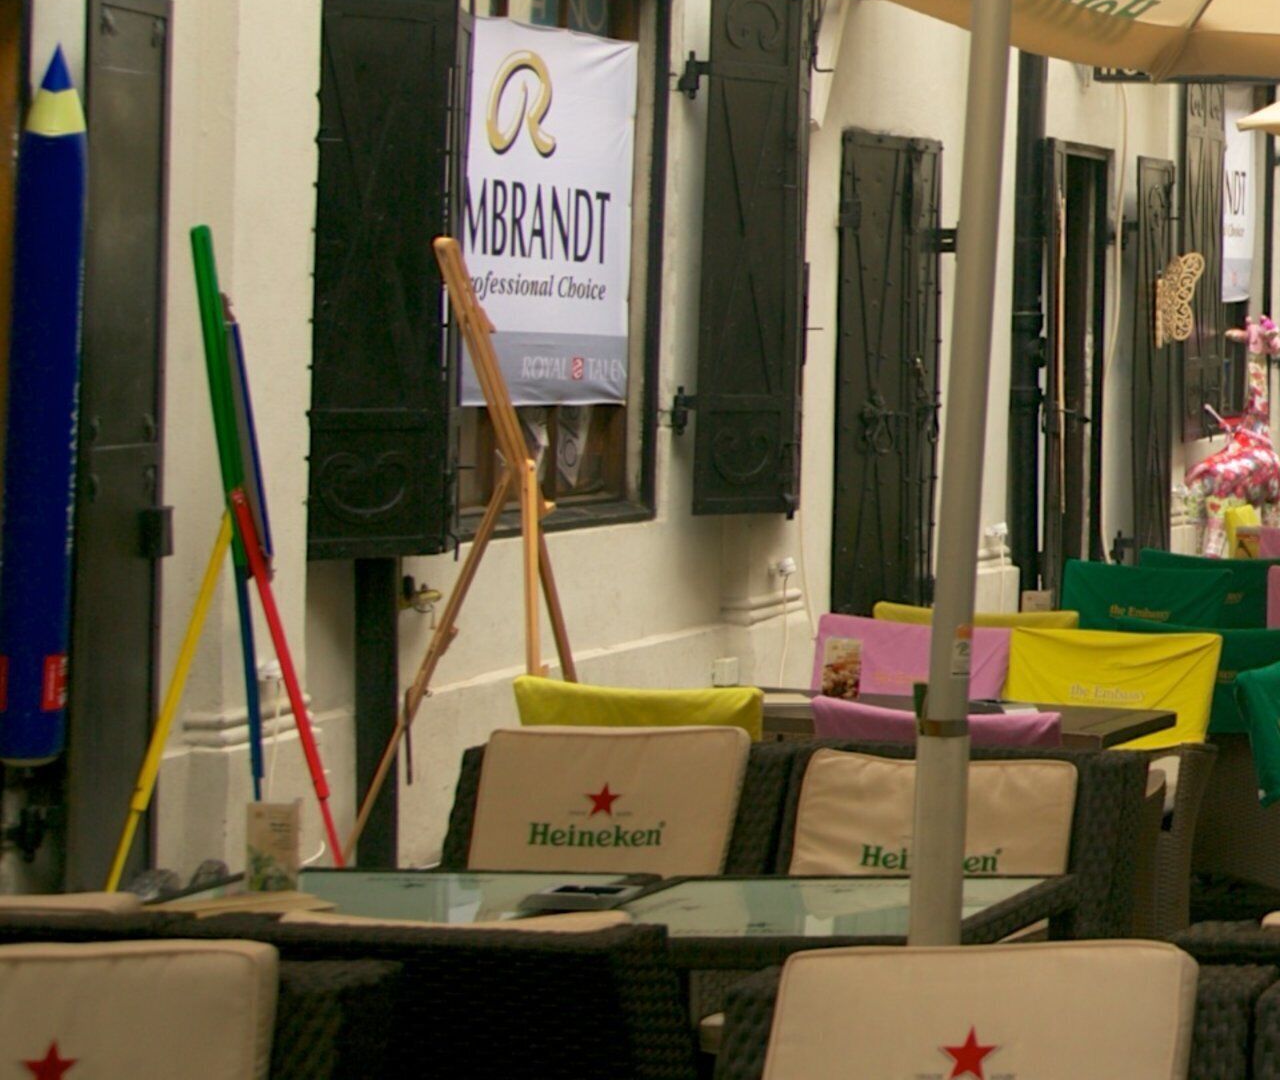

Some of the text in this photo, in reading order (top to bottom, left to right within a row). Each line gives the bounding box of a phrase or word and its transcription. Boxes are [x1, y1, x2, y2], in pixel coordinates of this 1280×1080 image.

[468, 273, 607, 301] rofessional Choice
[527, 821, 664, 848] Heineken
[859, 843, 1000, 873] Heien
